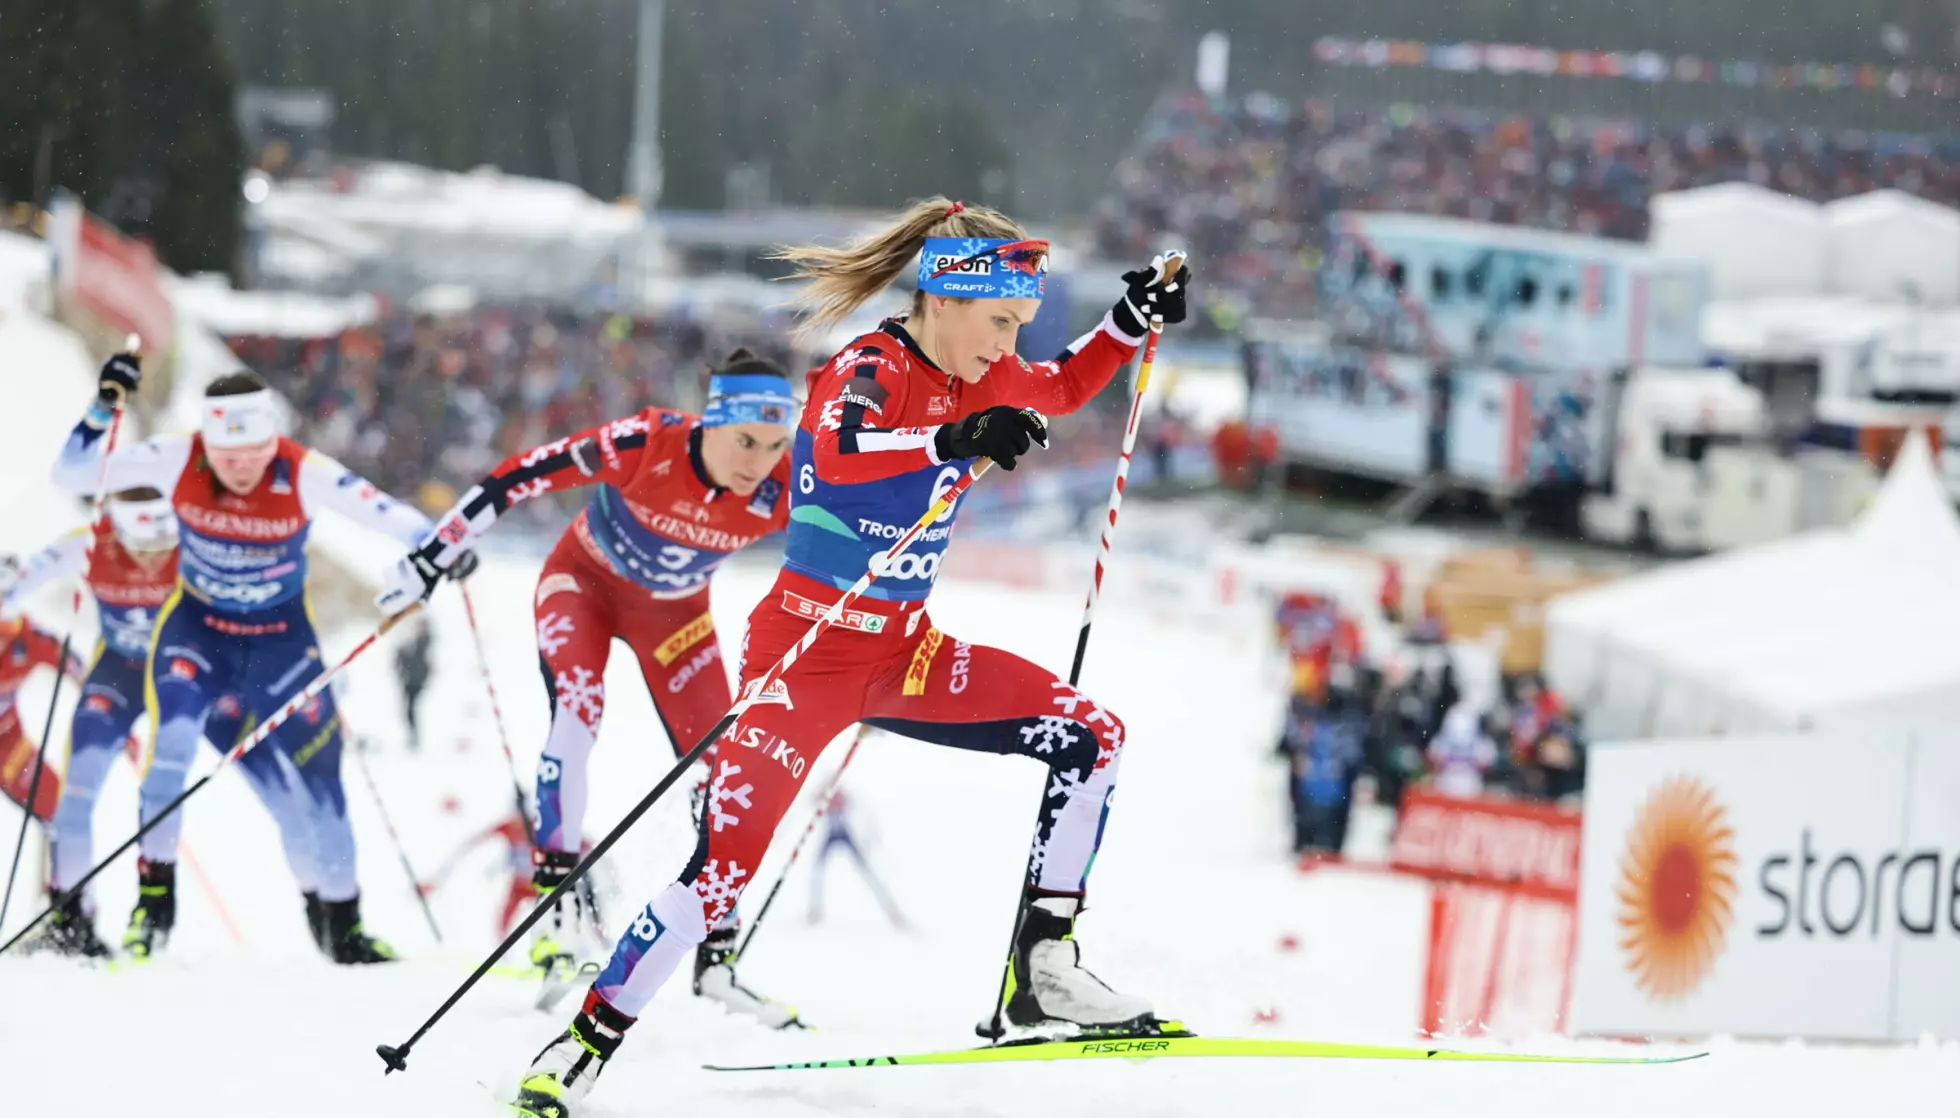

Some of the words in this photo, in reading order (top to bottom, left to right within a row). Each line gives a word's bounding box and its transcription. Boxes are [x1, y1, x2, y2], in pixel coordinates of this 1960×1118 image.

[943, 283, 985, 292] CRAFT
[800, 464, 815, 494] 6
[929, 466, 960, 522] 6
[1082, 1041, 1169, 1054] FISCHER
